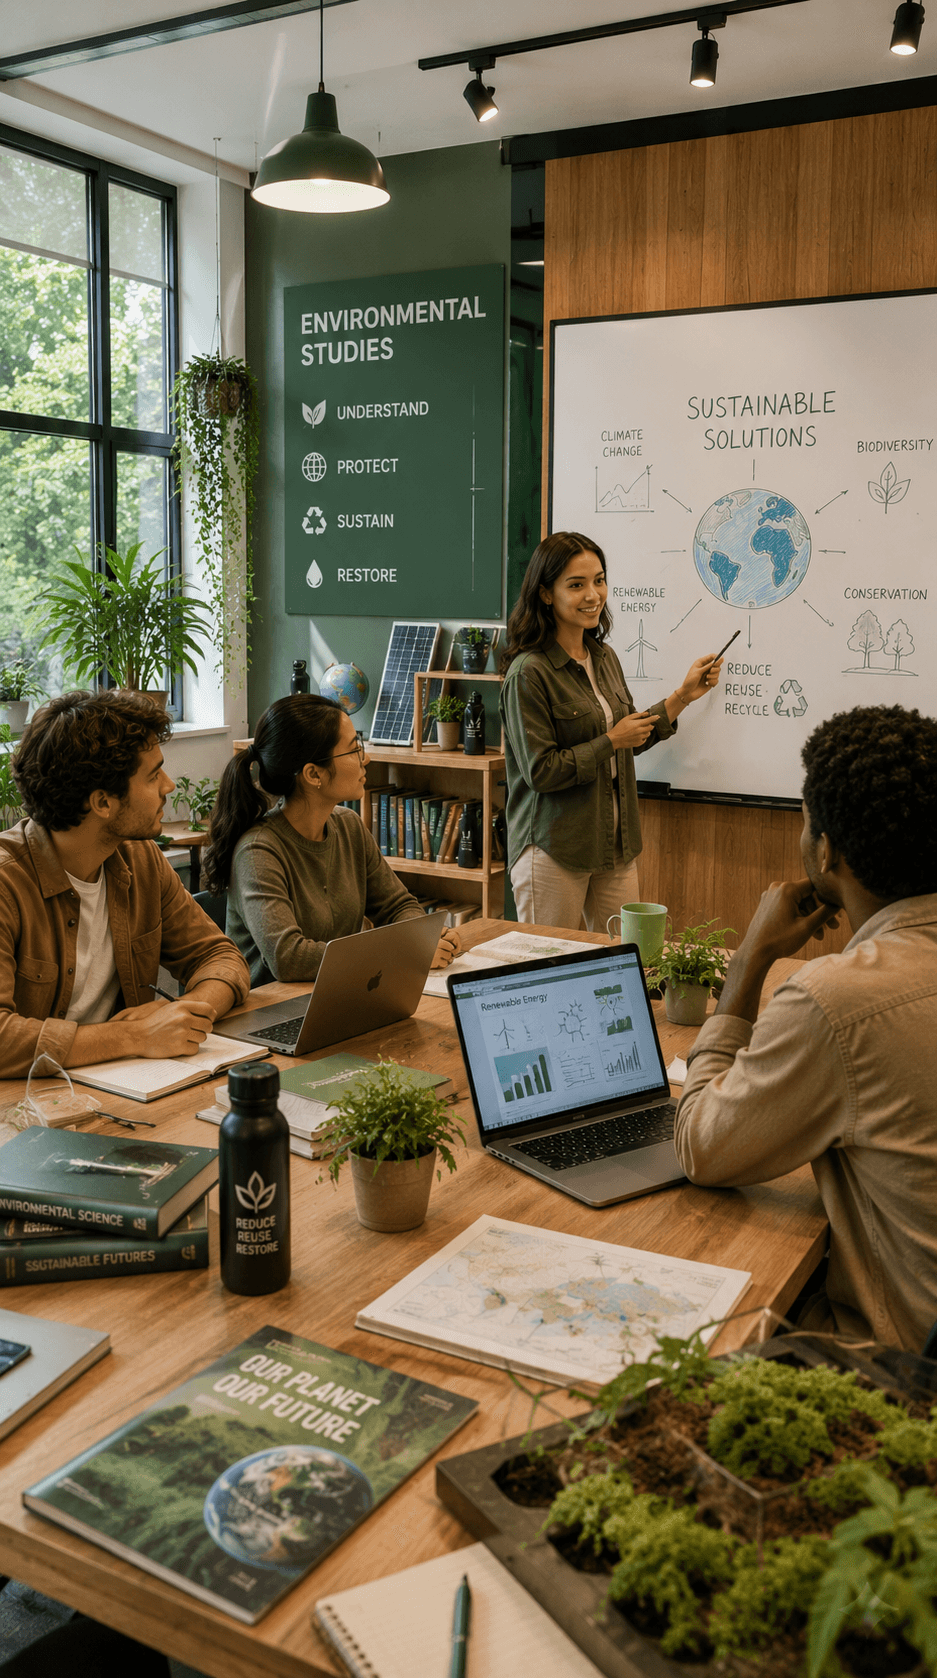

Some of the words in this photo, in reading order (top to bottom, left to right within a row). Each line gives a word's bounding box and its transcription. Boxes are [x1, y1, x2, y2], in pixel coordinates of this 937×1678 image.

[301, 296, 487, 335] ENVIRONMENTAL
[301, 337, 394, 366] STUDIES
[337, 401, 429, 420] UNDERSTAND
[687, 390, 836, 420] SUSTAINABLE
[601, 428, 643, 442] CLIMATE
[703, 425, 817, 450] SOLUTIONS
[602, 445, 643, 458] CHANGE
[857, 438, 934, 453] BIODIVERSITY
[337, 458, 399, 475] PROTECT
[337, 513, 394, 528] SUSTAIN
[337, 568, 398, 583] RESTORE
[843, 587, 928, 600] CONSERVATION
[620, 602, 657, 613] ENERGY
[727, 662, 772, 676] REDUCE
[725, 683, 762, 697] REUSE
[724, 702, 769, 716] RECYCLE
[522, 993, 548, 1004] Energy
[78, 1209, 124, 1227] SCIENCE
[235, 1215, 276, 1230] REDUCE
[237, 1229, 272, 1243] REUSE
[235, 1240, 279, 1255] RESTORE
[103, 1250, 156, 1265] FUTURES
[239, 1354, 293, 1384] OUR
[283, 1371, 382, 1417] PLANET
[212, 1373, 270, 1405] OUR
[258, 1392, 362, 1444] FUTURE
